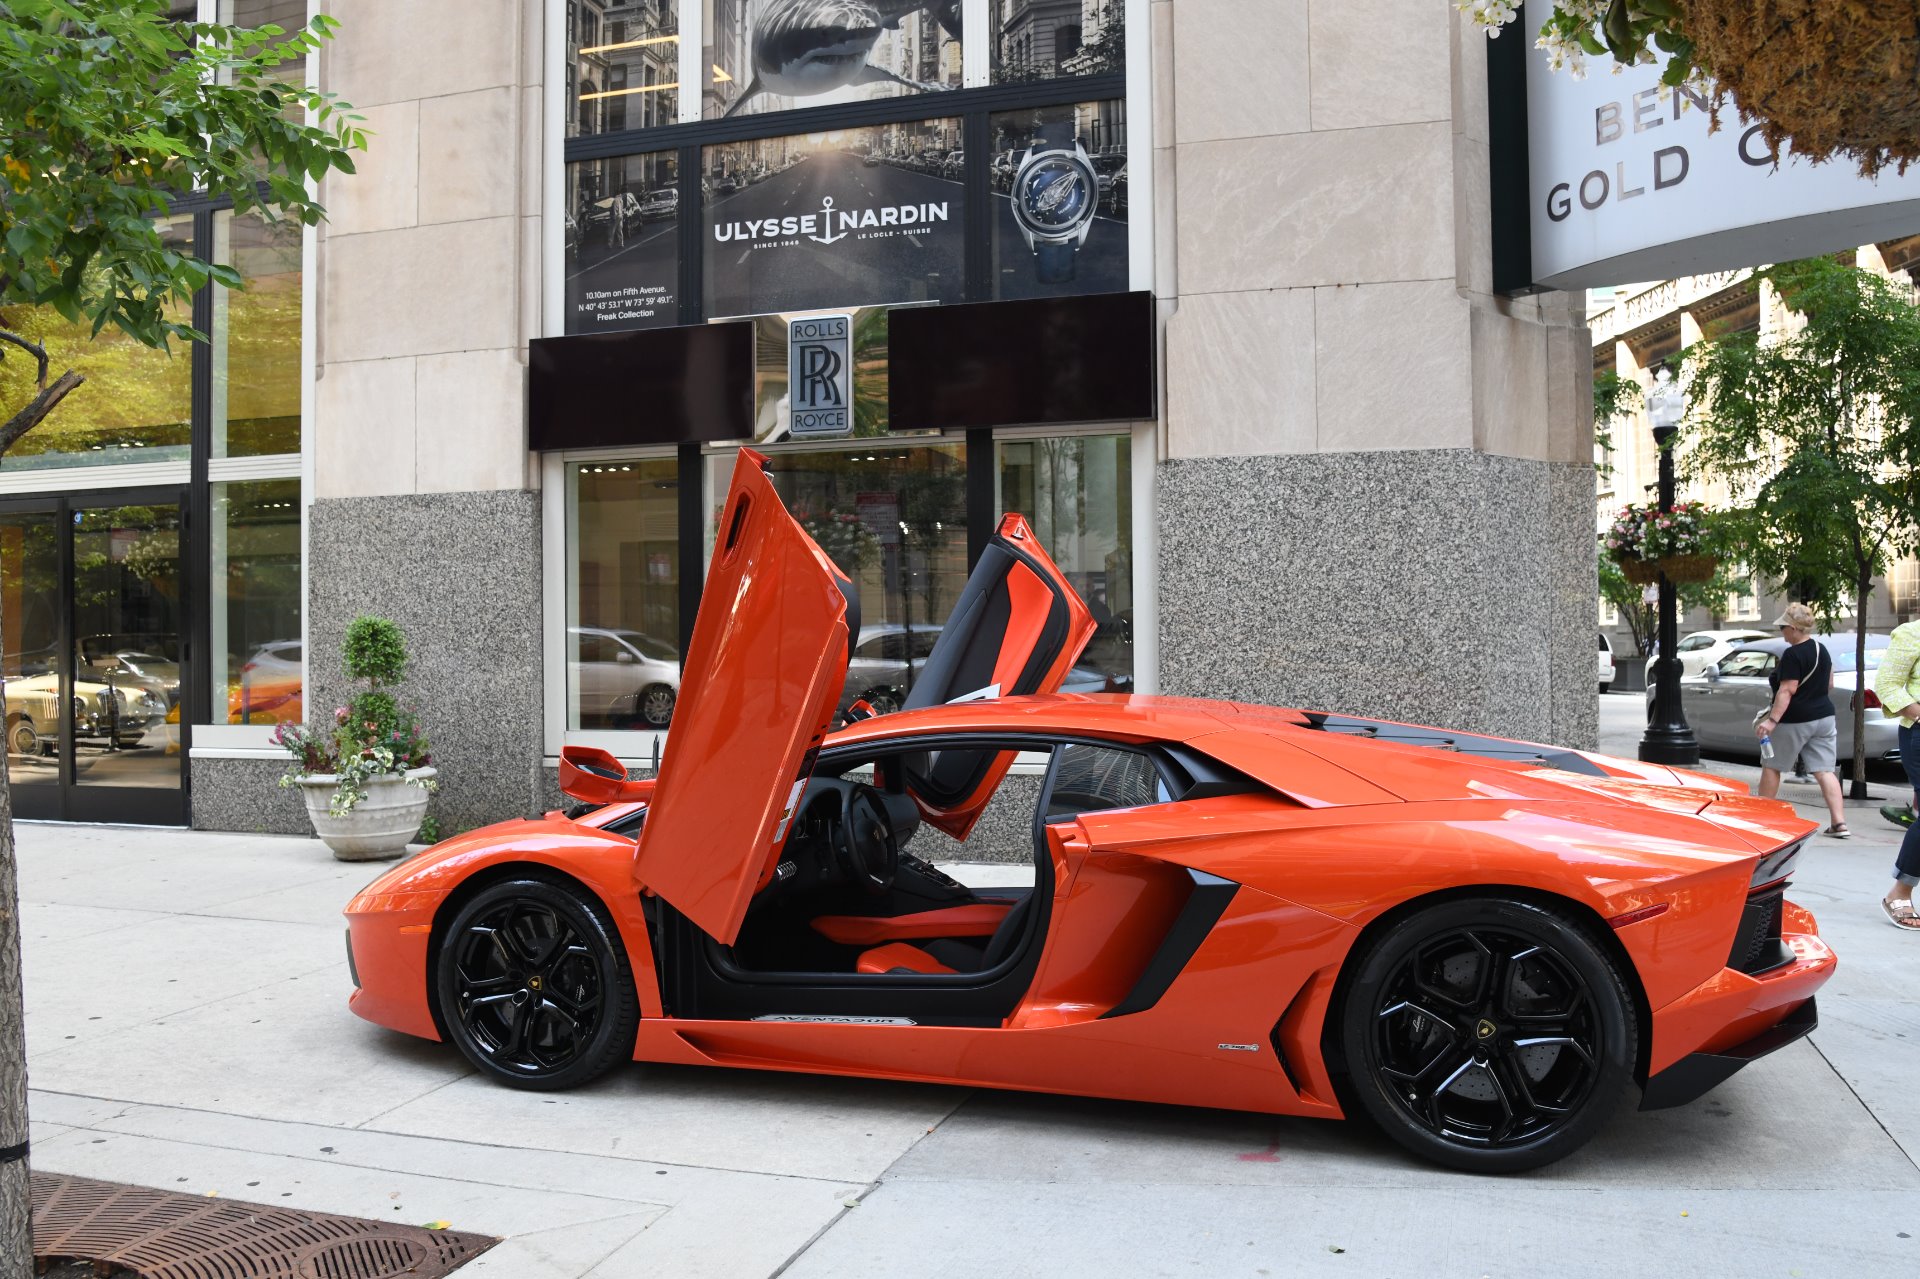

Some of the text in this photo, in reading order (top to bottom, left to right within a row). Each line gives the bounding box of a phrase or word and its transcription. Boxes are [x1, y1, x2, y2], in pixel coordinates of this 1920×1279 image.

[1595, 84, 1710, 147] BEN
[1546, 145, 1690, 222] GOLD
[714, 201, 949, 242] ULYSSE NARDIN
[869, 231, 894, 239] LOCLE
[902, 227, 931, 236] SUISSE
[753, 241, 778, 250] SINCE
[586, 291, 611, 300] 10.10am
[623, 287, 639, 296] Fifth
[639, 286, 667, 294] Avenue.
[578, 304, 584, 312] N
[624, 299, 633, 307] W
[597, 309, 654, 321] Freak Collection
[794, 322, 844, 338] ROLLS
[794, 412, 844, 428] ROYCE
